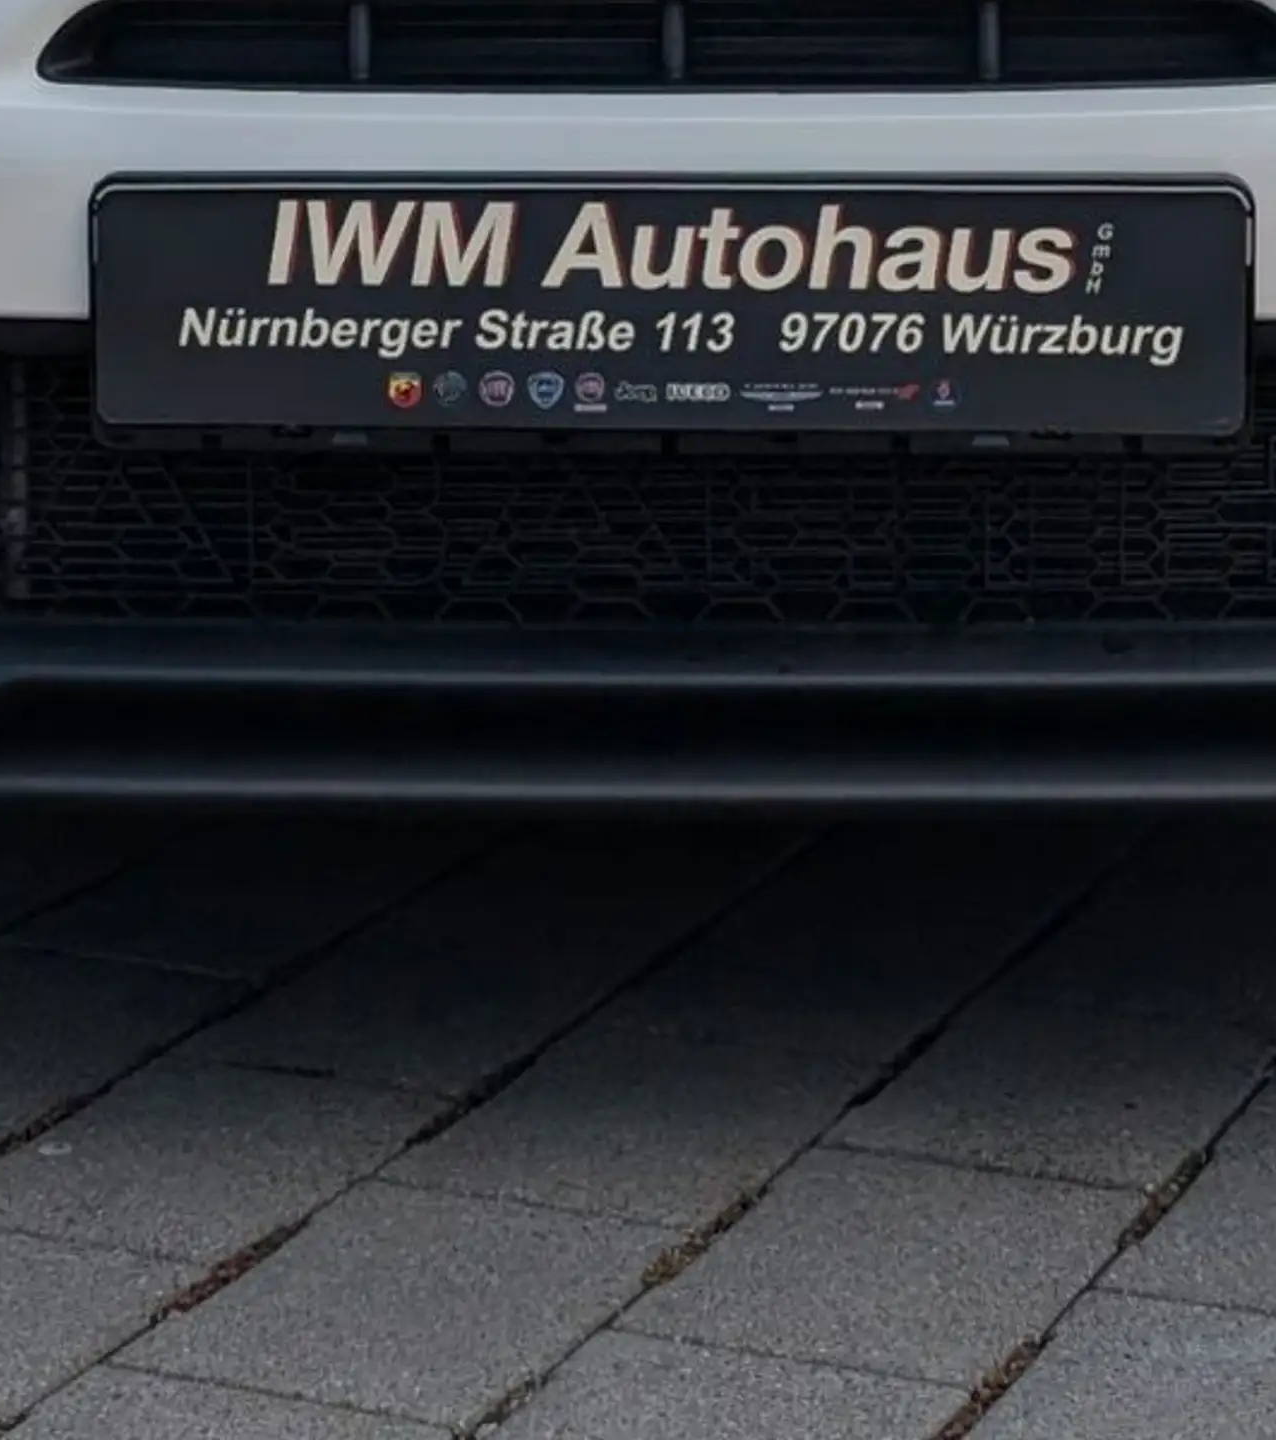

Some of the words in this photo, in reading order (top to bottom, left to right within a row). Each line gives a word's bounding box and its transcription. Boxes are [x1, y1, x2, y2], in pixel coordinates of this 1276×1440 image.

[267, 198, 517, 287] IWM
[540, 201, 1074, 294] Autohaus
[178, 307, 462, 358] Nürnberger
[475, 308, 635, 352] Straße
[655, 311, 735, 352] 113
[778, 311, 925, 353] 97076
[942, 313, 1183, 366] Würzburg
